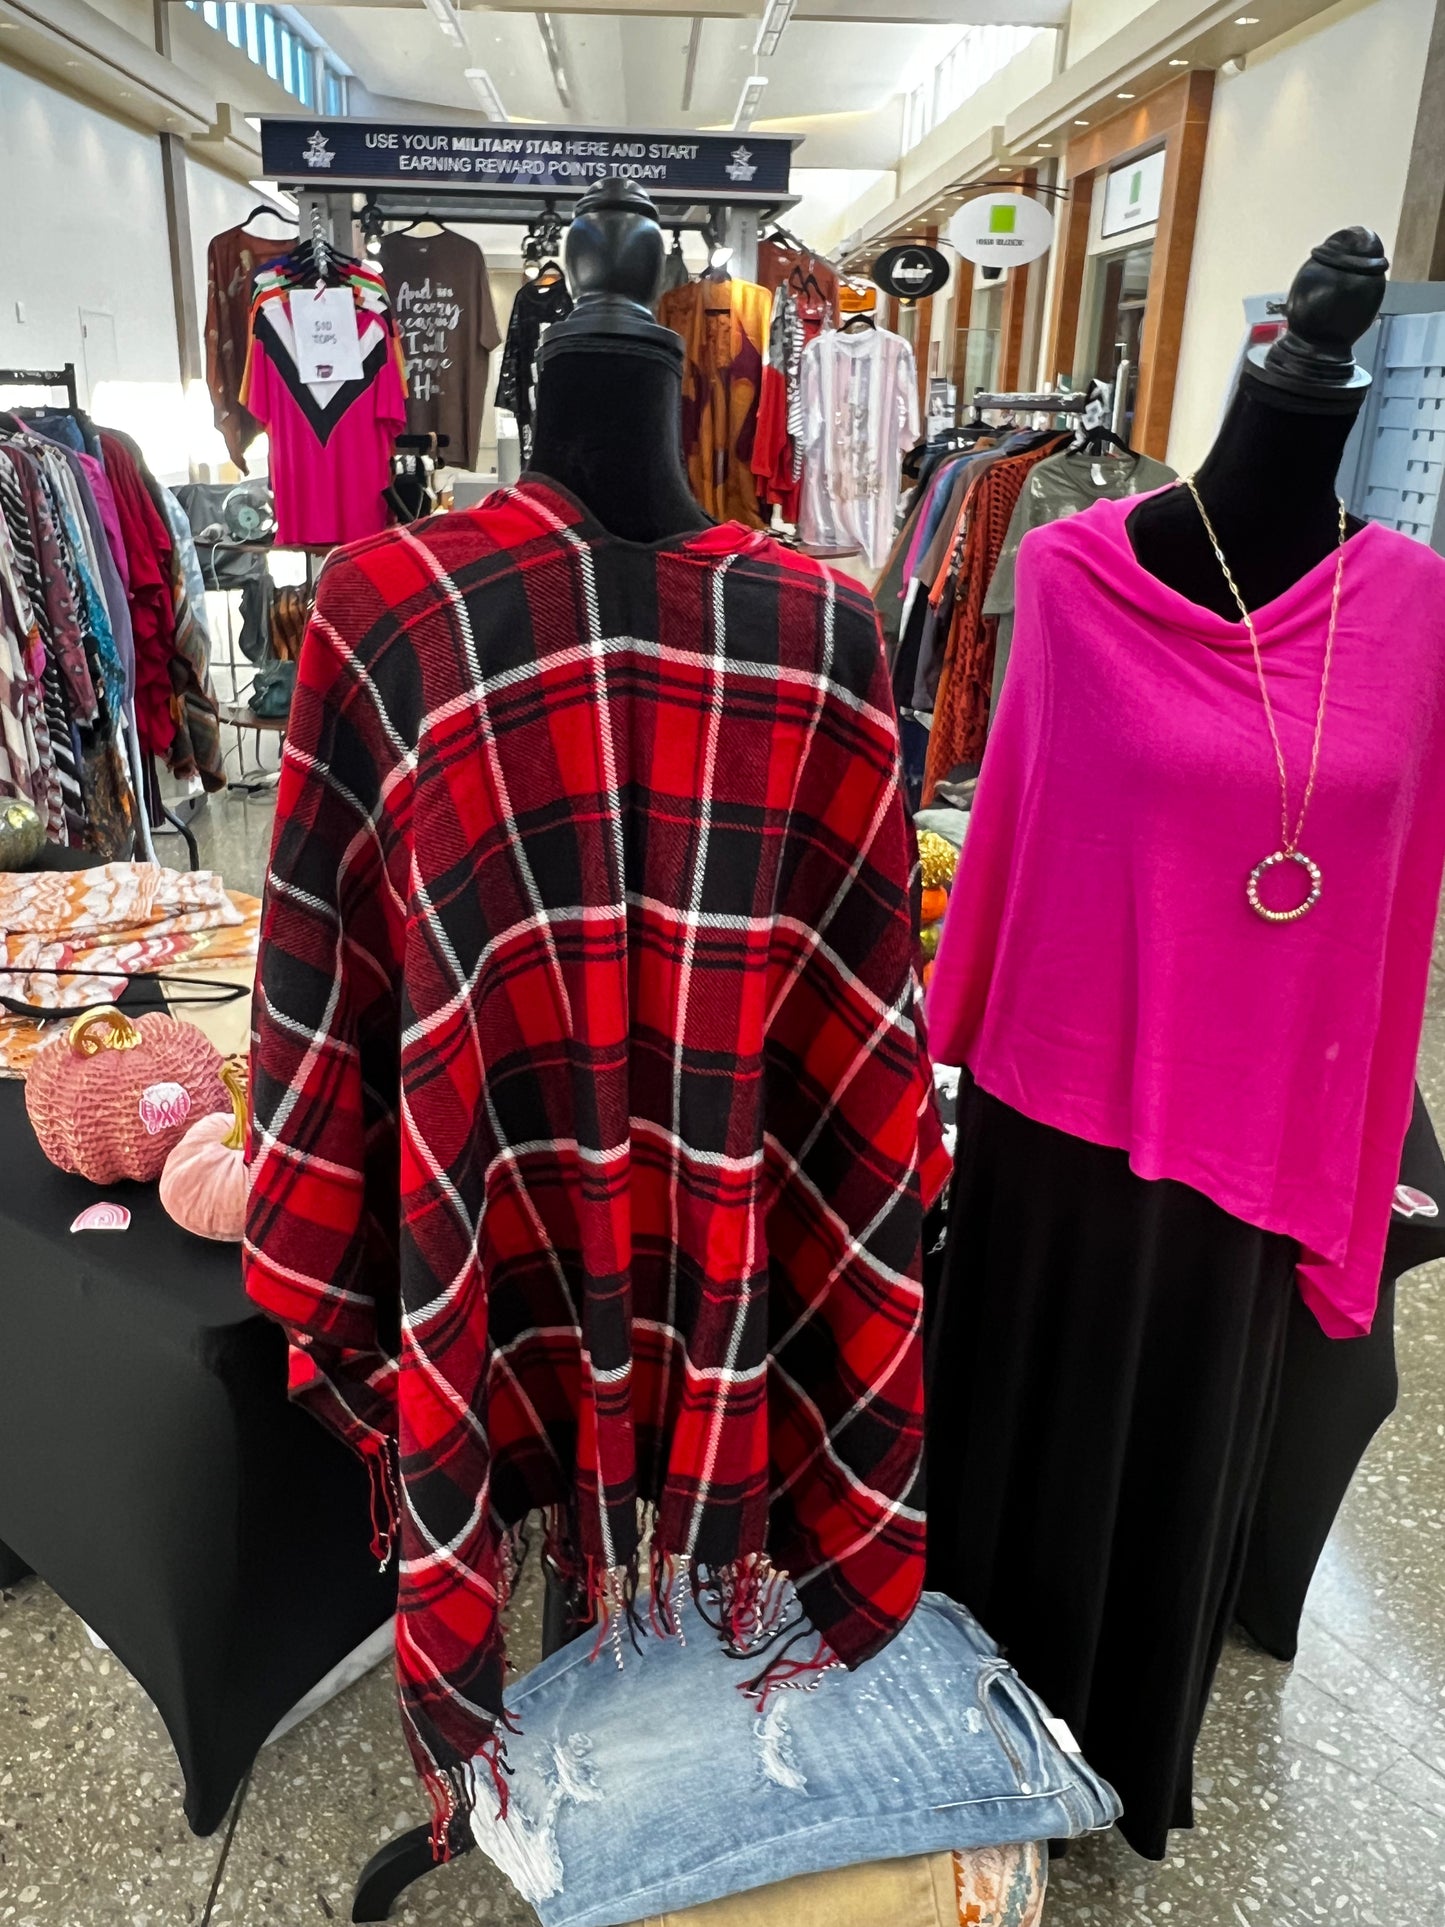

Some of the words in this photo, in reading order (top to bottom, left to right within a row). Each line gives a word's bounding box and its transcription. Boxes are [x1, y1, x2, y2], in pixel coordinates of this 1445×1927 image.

[365, 133, 399, 149] USE
[402, 134, 449, 150] YOUR
[452, 137, 524, 153] MILITARY
[525, 140, 563, 155] STAR
[565, 141, 610, 157] HERE
[611, 143, 646, 158] AND
[648, 144, 700, 160] START
[399, 155, 472, 172] EARNING
[474, 158, 545, 174] REWARD
[547, 160, 607, 178] POINTS
[609, 163, 668, 180] TODAY!
